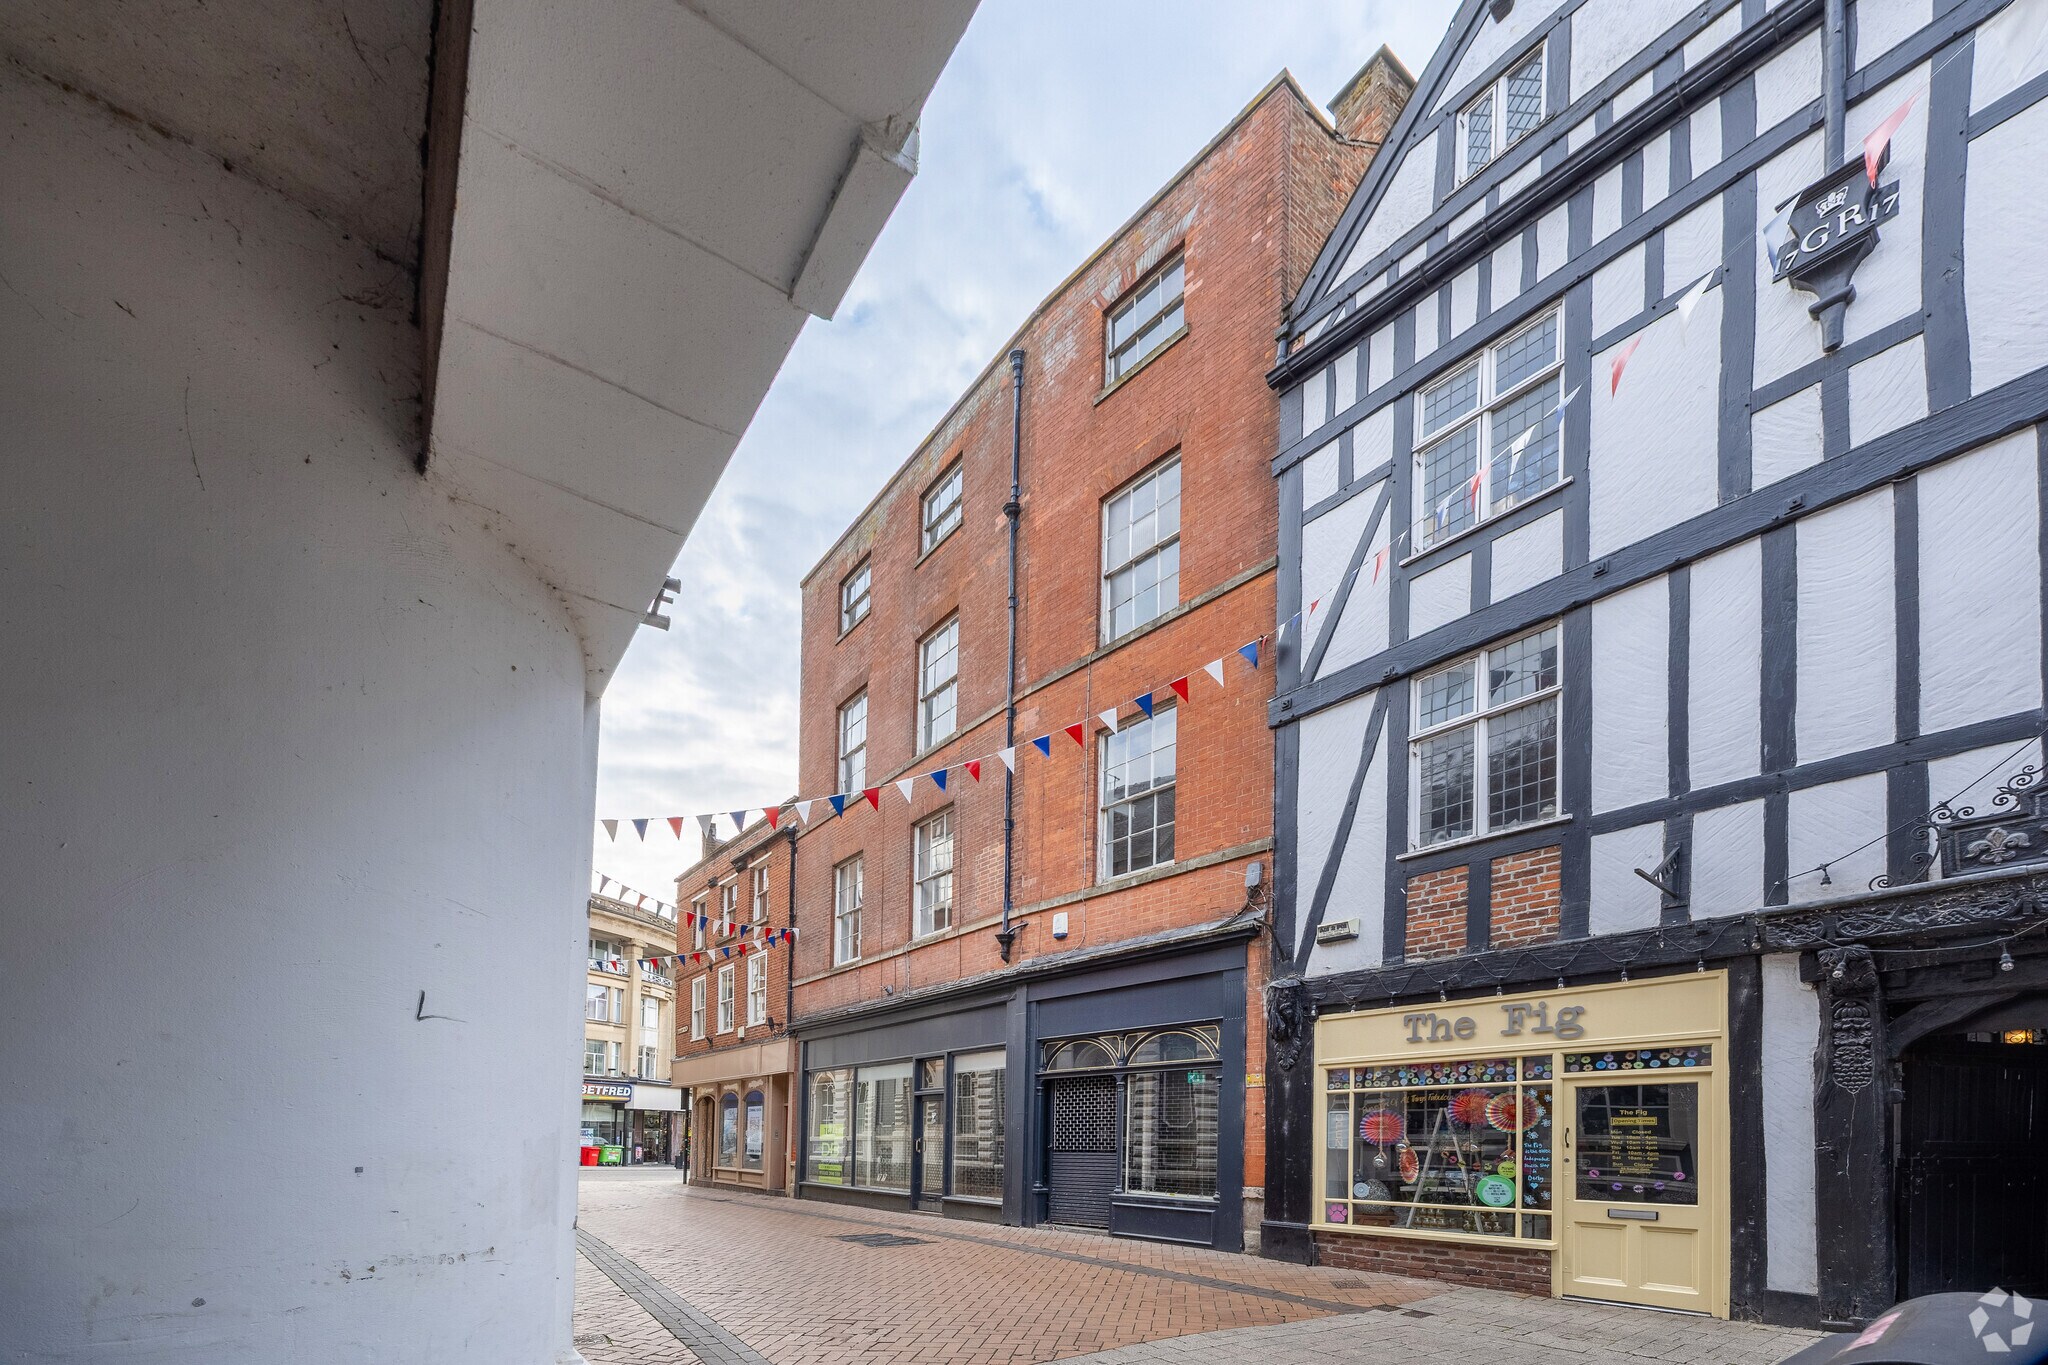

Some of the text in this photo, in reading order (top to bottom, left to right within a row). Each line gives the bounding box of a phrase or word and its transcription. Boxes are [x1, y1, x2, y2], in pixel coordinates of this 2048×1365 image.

[1869, 192, 1899, 222] 17
[1404, 1001, 1586, 1043] The Fig
[1527, 1175, 1544, 1183] Derby
